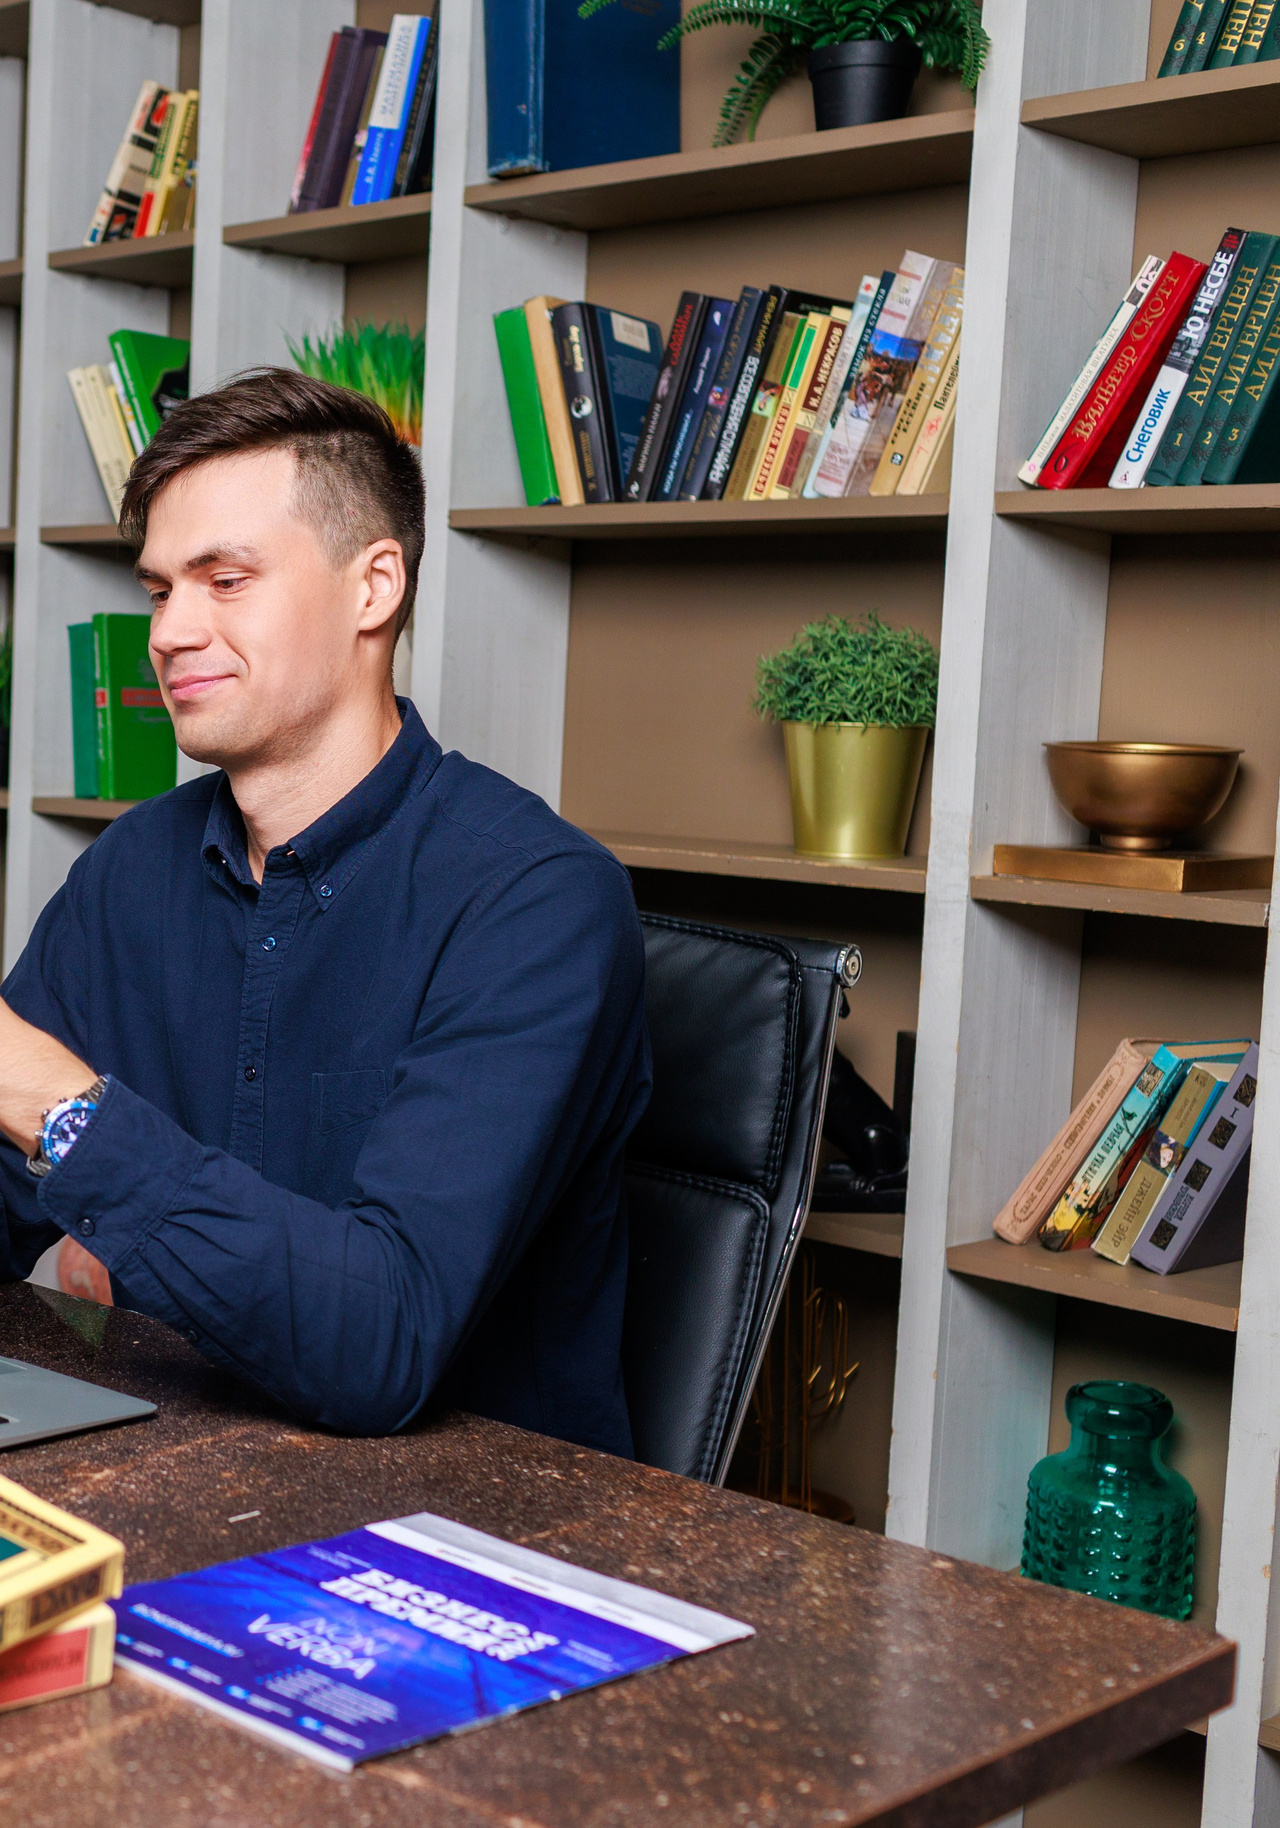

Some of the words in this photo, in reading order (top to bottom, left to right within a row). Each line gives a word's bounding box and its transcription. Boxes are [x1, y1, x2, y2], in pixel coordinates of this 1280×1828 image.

[1174, 39, 1185, 51] 6
[1196, 32, 1206, 45] 4
[760, 293, 778, 326] РЕНИ
[866, 286, 888, 327] СТЕКЛА
[751, 323, 769, 355] НАЙТ
[861, 327, 873, 343] ИЗ
[1183, 315, 1204, 341] Ю
[741, 354, 760, 376] ВСЕ
[814, 325, 844, 384] НЕКРАСОВ
[847, 343, 867, 379] ЗАМОК
[811, 381, 825, 396] А.
[1056, 367, 1095, 423] МАЛАХИТОВАЯ
[1088, 325, 1120, 368] ШКАТУЛКА
[901, 380, 927, 434] ЕСЕНИН
[1071, 345, 1138, 443] ВАЛЬТЕР
[1173, 433, 1183, 447] 1
[1202, 431, 1213, 445] 2
[1228, 428, 1239, 442] 3
[707, 427, 739, 486] СЛУЧАЙНЫ
[1080, 1150, 1108, 1185] ПТИЧКА
[1098, 1121, 1126, 1155] ПЕВЧАЯ
[1119, 1174, 1155, 1226] ДЖЕЙН
[1108, 1220, 1130, 1249] ЭЙР
